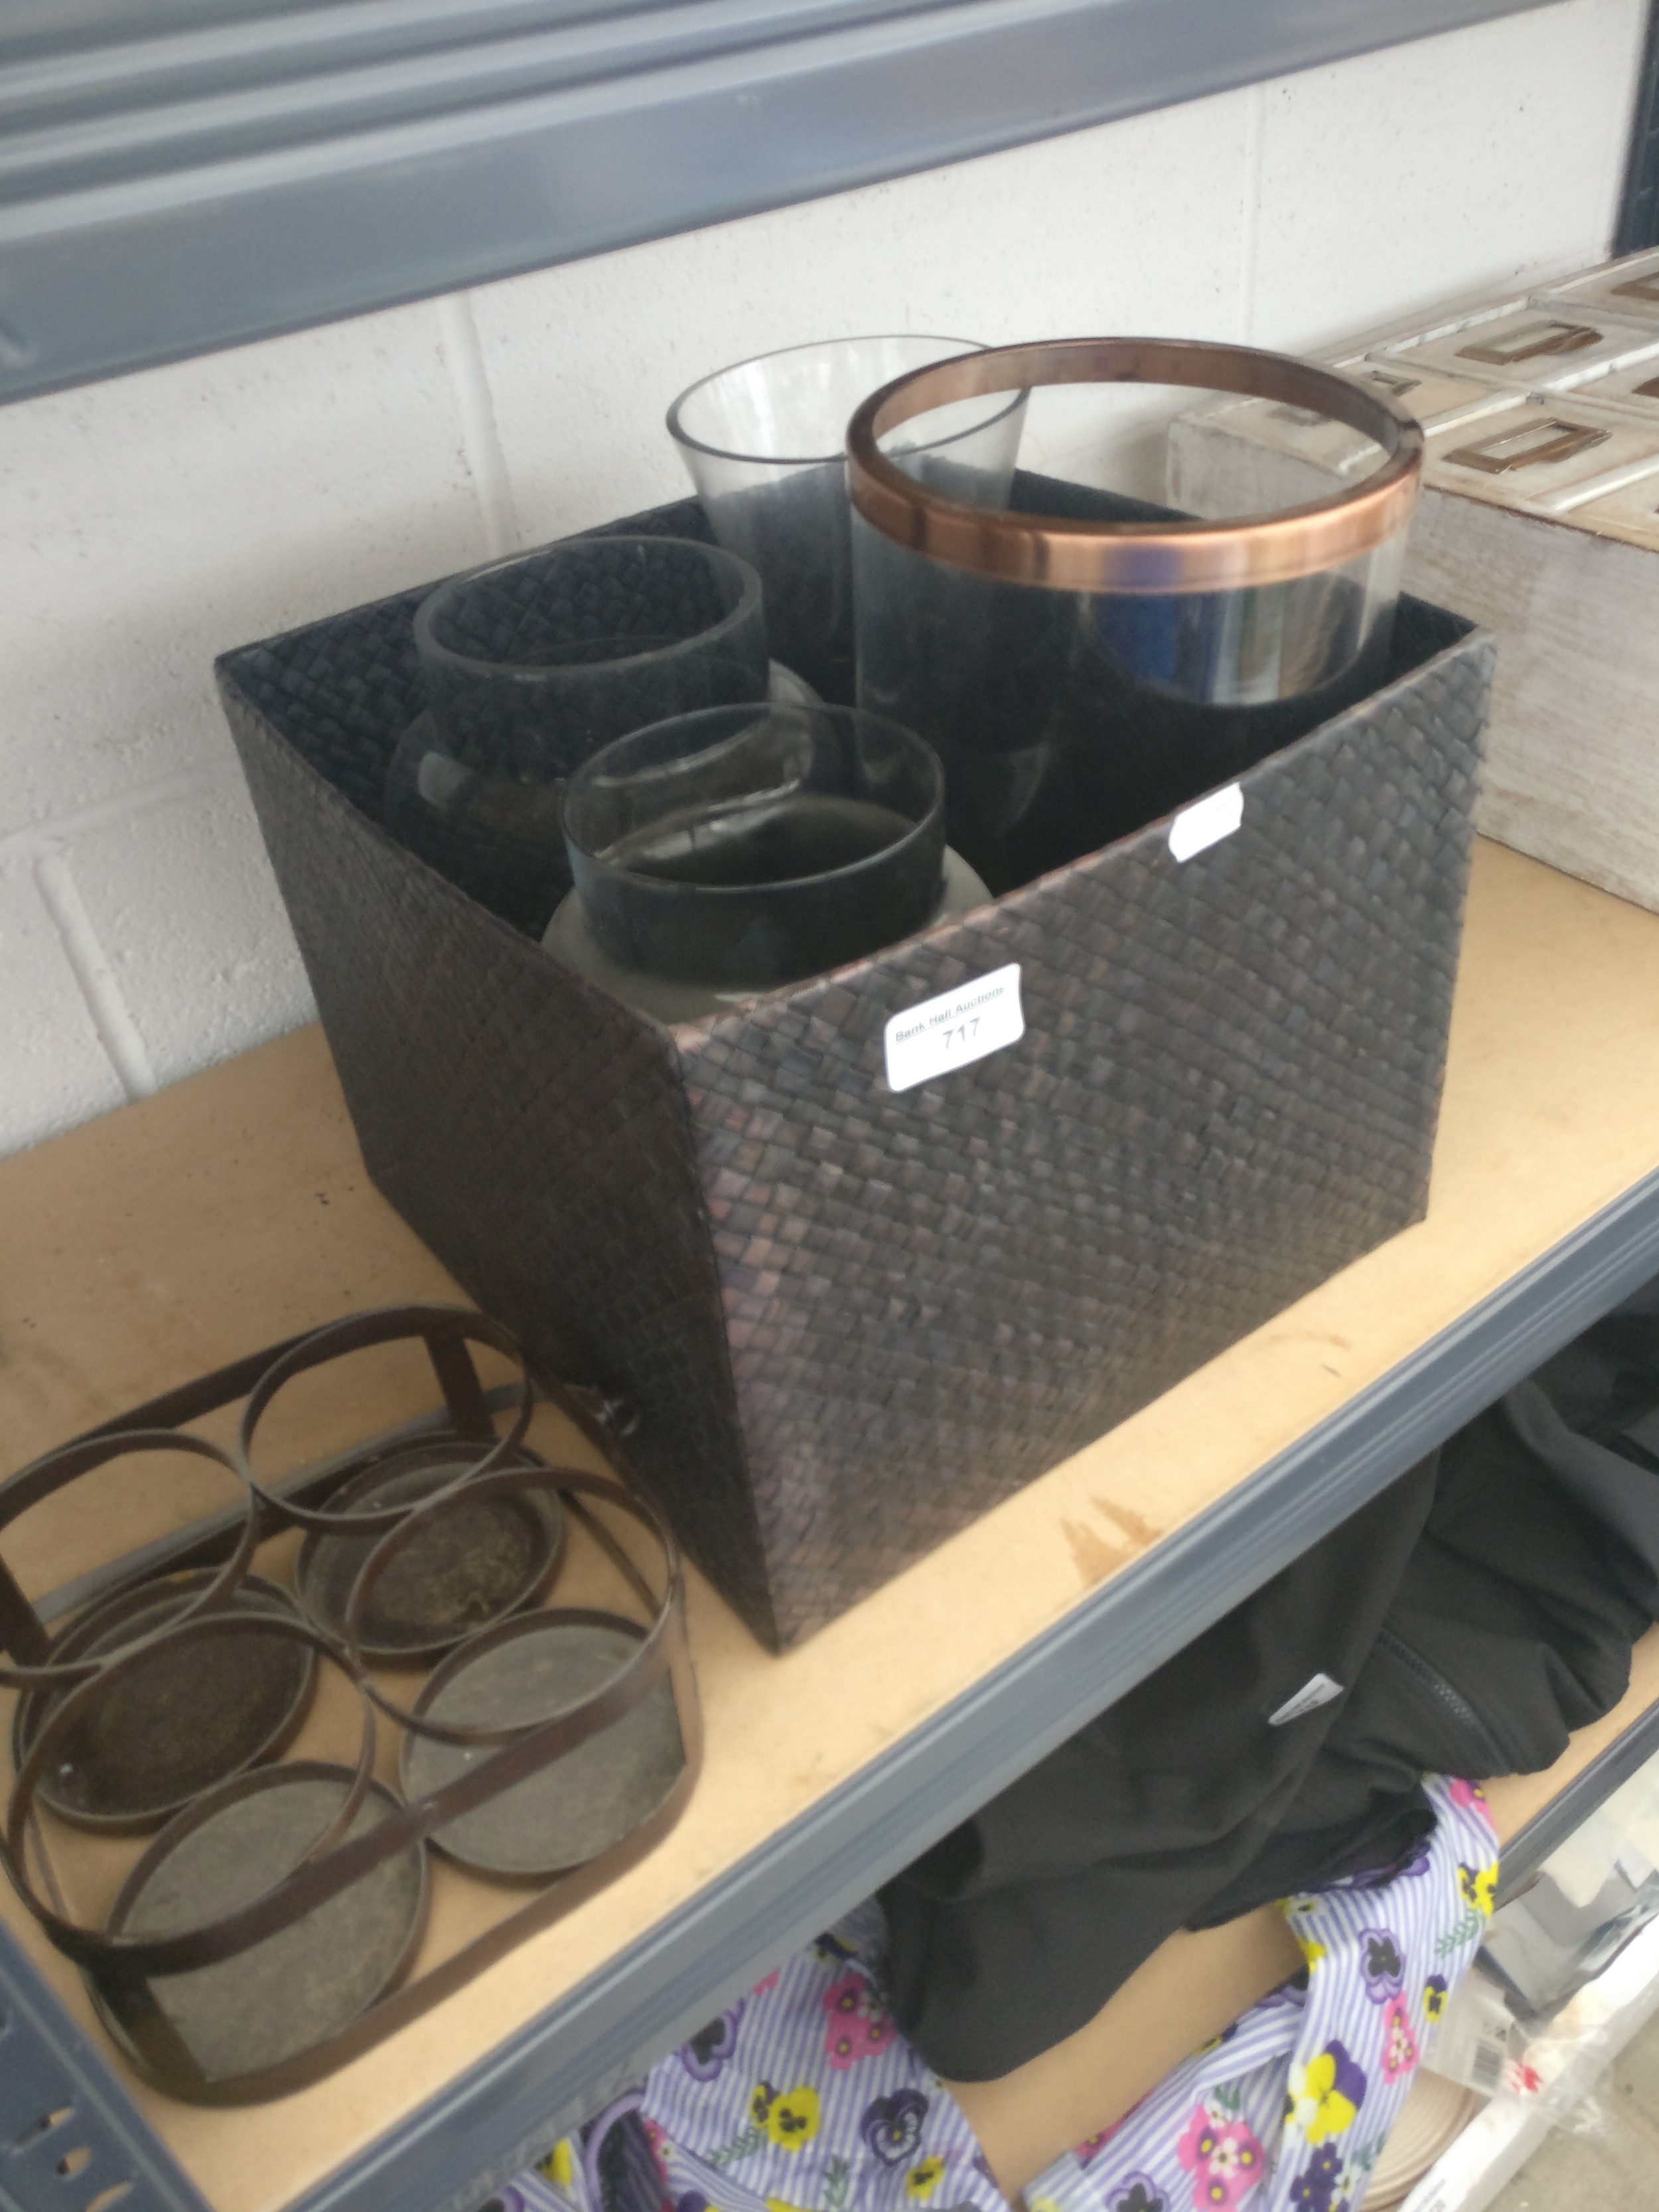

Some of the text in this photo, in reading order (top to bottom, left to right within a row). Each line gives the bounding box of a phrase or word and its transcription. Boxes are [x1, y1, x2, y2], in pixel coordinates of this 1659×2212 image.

[896, 986, 1005, 1041] Bank Hall Auctions
[943, 1017, 980, 1049] 717
